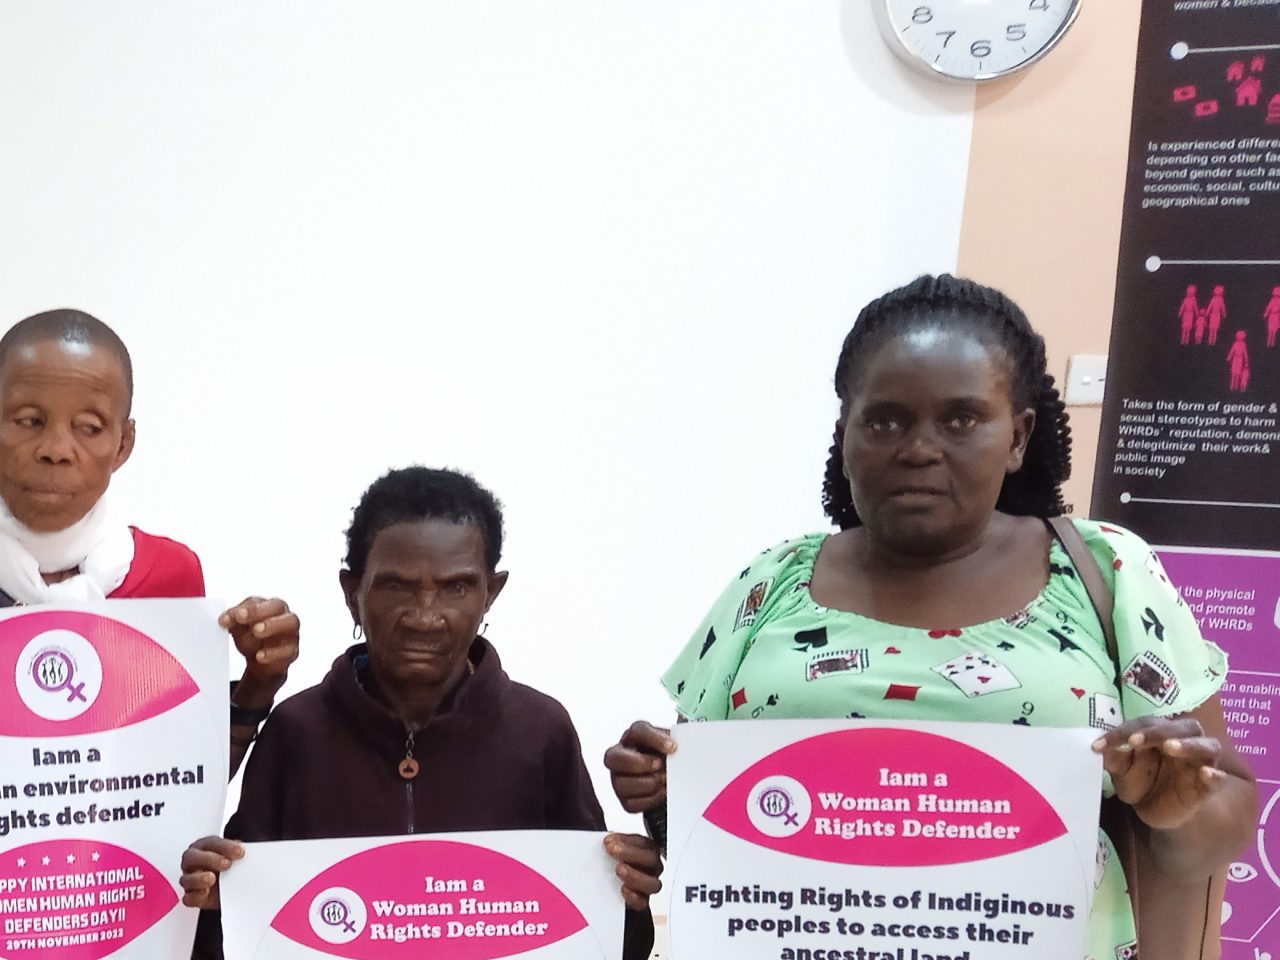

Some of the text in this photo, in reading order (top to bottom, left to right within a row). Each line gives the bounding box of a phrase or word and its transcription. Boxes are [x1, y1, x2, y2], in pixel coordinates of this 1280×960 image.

[23, 765, 204, 798] environmental
[56, 800, 165, 826] defender
[818, 792, 911, 812] Woman
[917, 795, 1012, 814] Human
[815, 817, 1020, 840] Rights Defender
[31, 866, 144, 890] INTERNATIONAL
[40, 894, 95, 911] HUMAN
[99, 886, 145, 904] RIGHTS
[372, 900, 453, 918] Woman
[459, 899, 539, 915] Human
[685, 885, 1075, 920] Fighting Rights of Indiginous
[5, 914, 89, 934] DEFENDERS
[370, 920, 548, 942] Rights Defender
[728, 915, 1034, 946] peoples to access their
